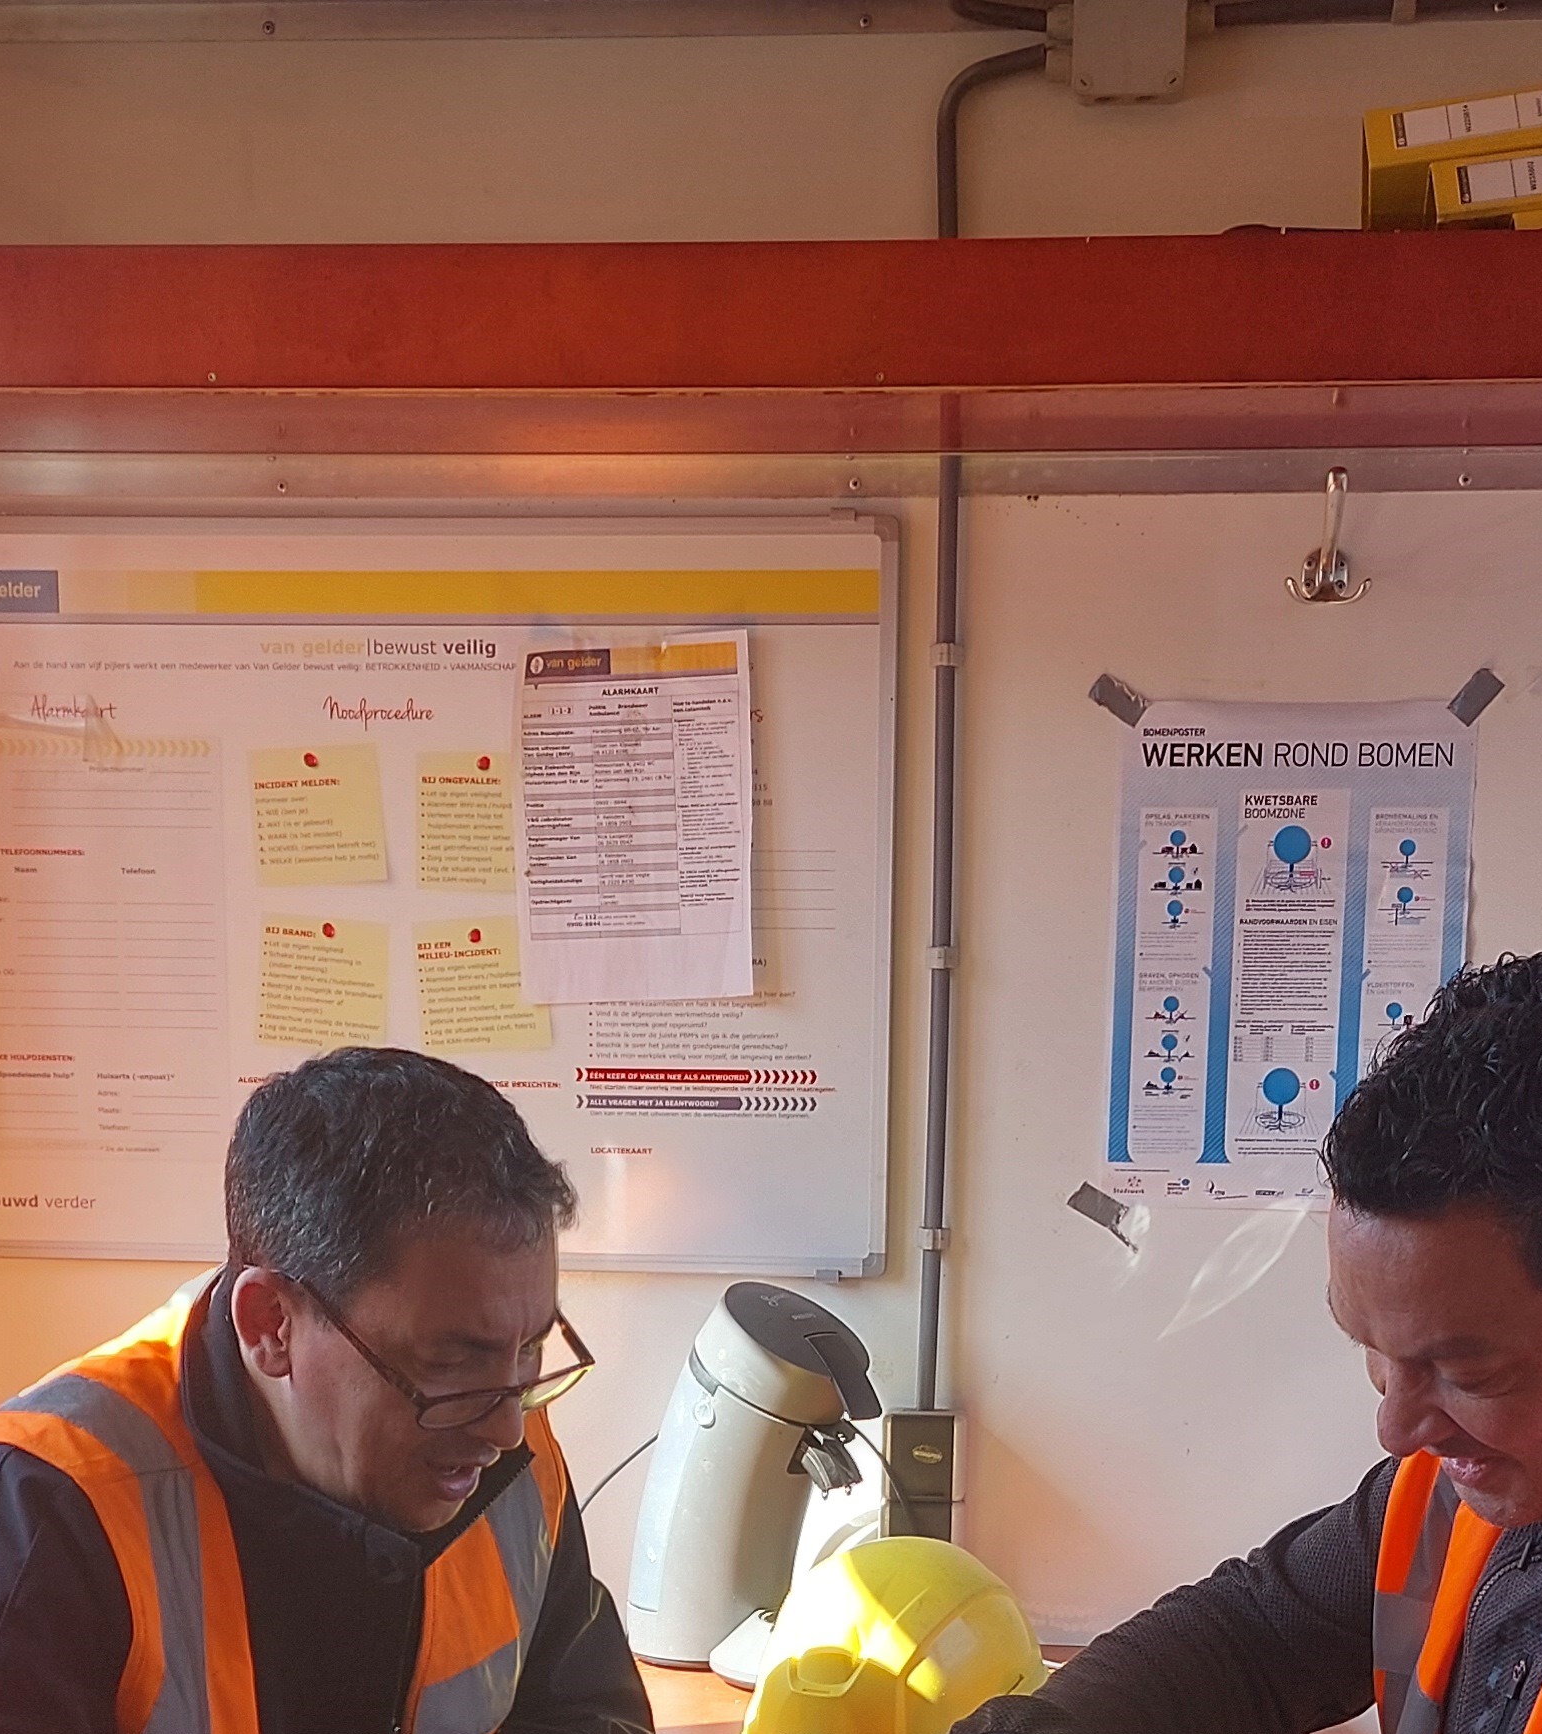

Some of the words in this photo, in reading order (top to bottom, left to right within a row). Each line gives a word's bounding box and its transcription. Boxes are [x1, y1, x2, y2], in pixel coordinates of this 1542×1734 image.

[261, 641, 298, 655] van
[303, 640, 364, 658] gelder
[374, 640, 436, 655] bewust
[443, 639, 497, 657] veilig
[46, 661, 67, 669] hand
[133, 661, 157, 670] werkt
[179, 662, 231, 671] medewerker
[253, 662, 270, 670] Van
[272, 662, 301, 671] Gelder
[304, 663, 334, 671] bewust
[547, 658, 563, 668] van
[568, 657, 602, 671] gelder
[602, 687, 659, 697] ALARMKAART
[30, 695, 117, 719] Alarmkrt
[323, 695, 434, 731] Noodprocedure
[1143, 728, 1205, 737] BOMENPOSTER
[1142, 743, 1263, 767] WERKEN
[1274, 743, 1348, 767] ROND
[1358, 743, 1454, 767] BOMEN
[255, 781, 298, 789] INCIDENT
[301, 779, 340, 787] MELDEN:
[439, 777, 501, 785] ONGEVALLEN:
[1245, 795, 1318, 806] KWETSBARE
[1244, 808, 1305, 819] BOOMZONE
[283, 928, 316, 938] BRAND:
[418, 948, 501, 960] MILIEU-INCIDENT:
[11, 1054, 75, 1062] HULPDIENSTEN:
[45, 1195, 96, 1208] verder
